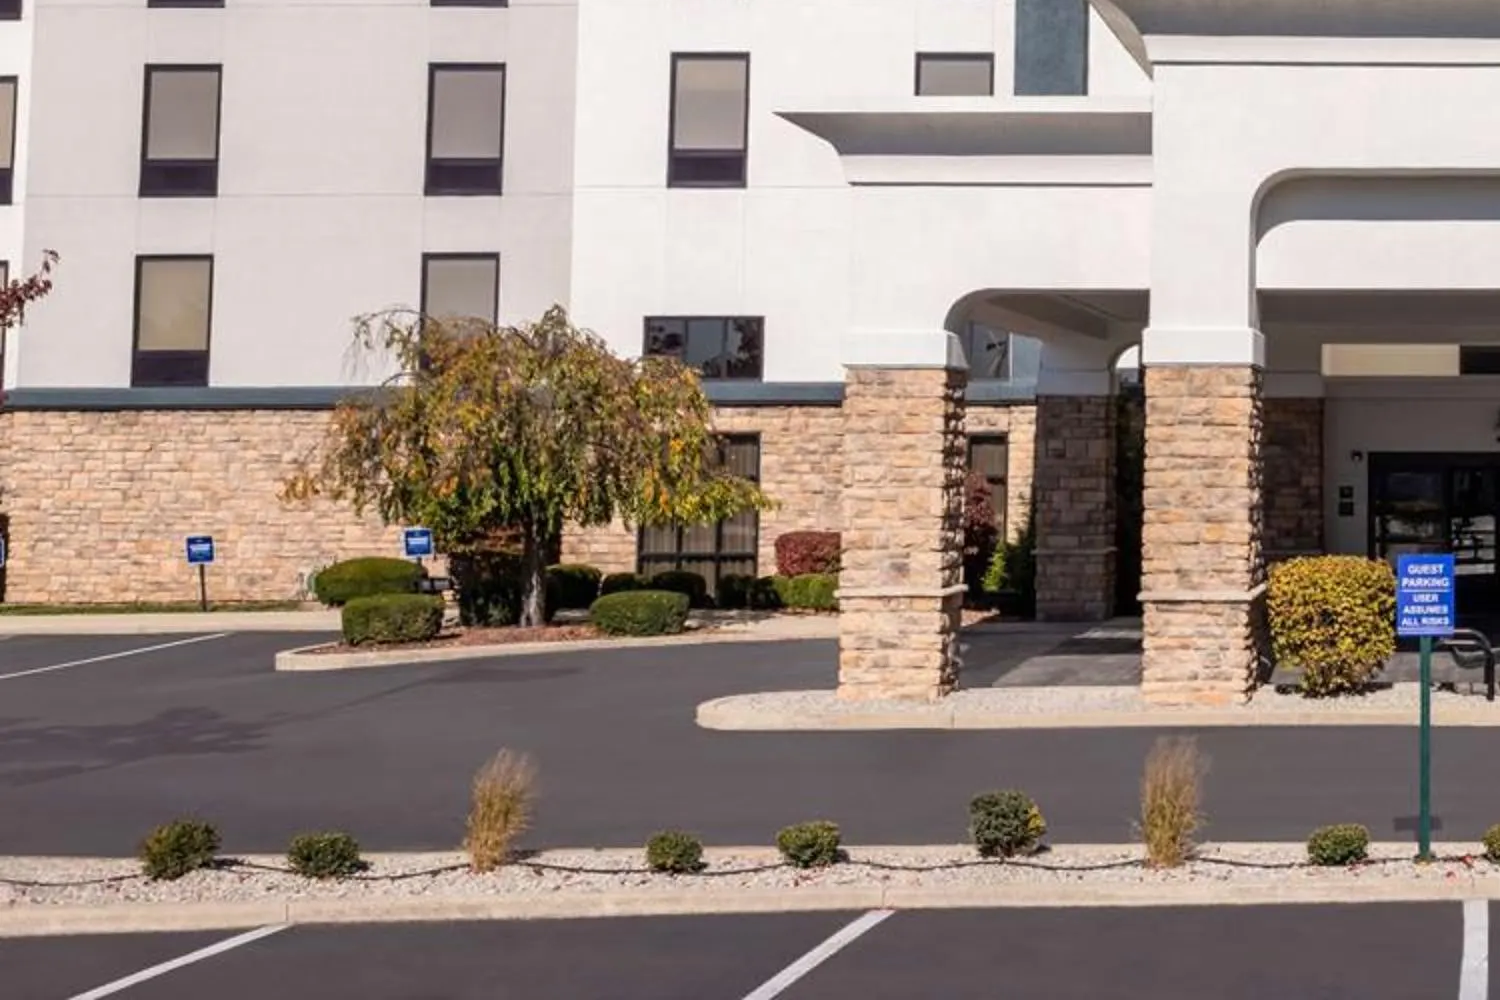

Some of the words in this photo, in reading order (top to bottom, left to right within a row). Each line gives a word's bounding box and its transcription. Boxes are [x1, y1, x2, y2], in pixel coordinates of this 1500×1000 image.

[1408, 564, 1444, 575] GUEST
[1402, 577, 1449, 588] PARKING
[1413, 594, 1438, 603] USER
[1403, 605, 1448, 614] ASSUMES
[1402, 617, 1419, 626] ALL
